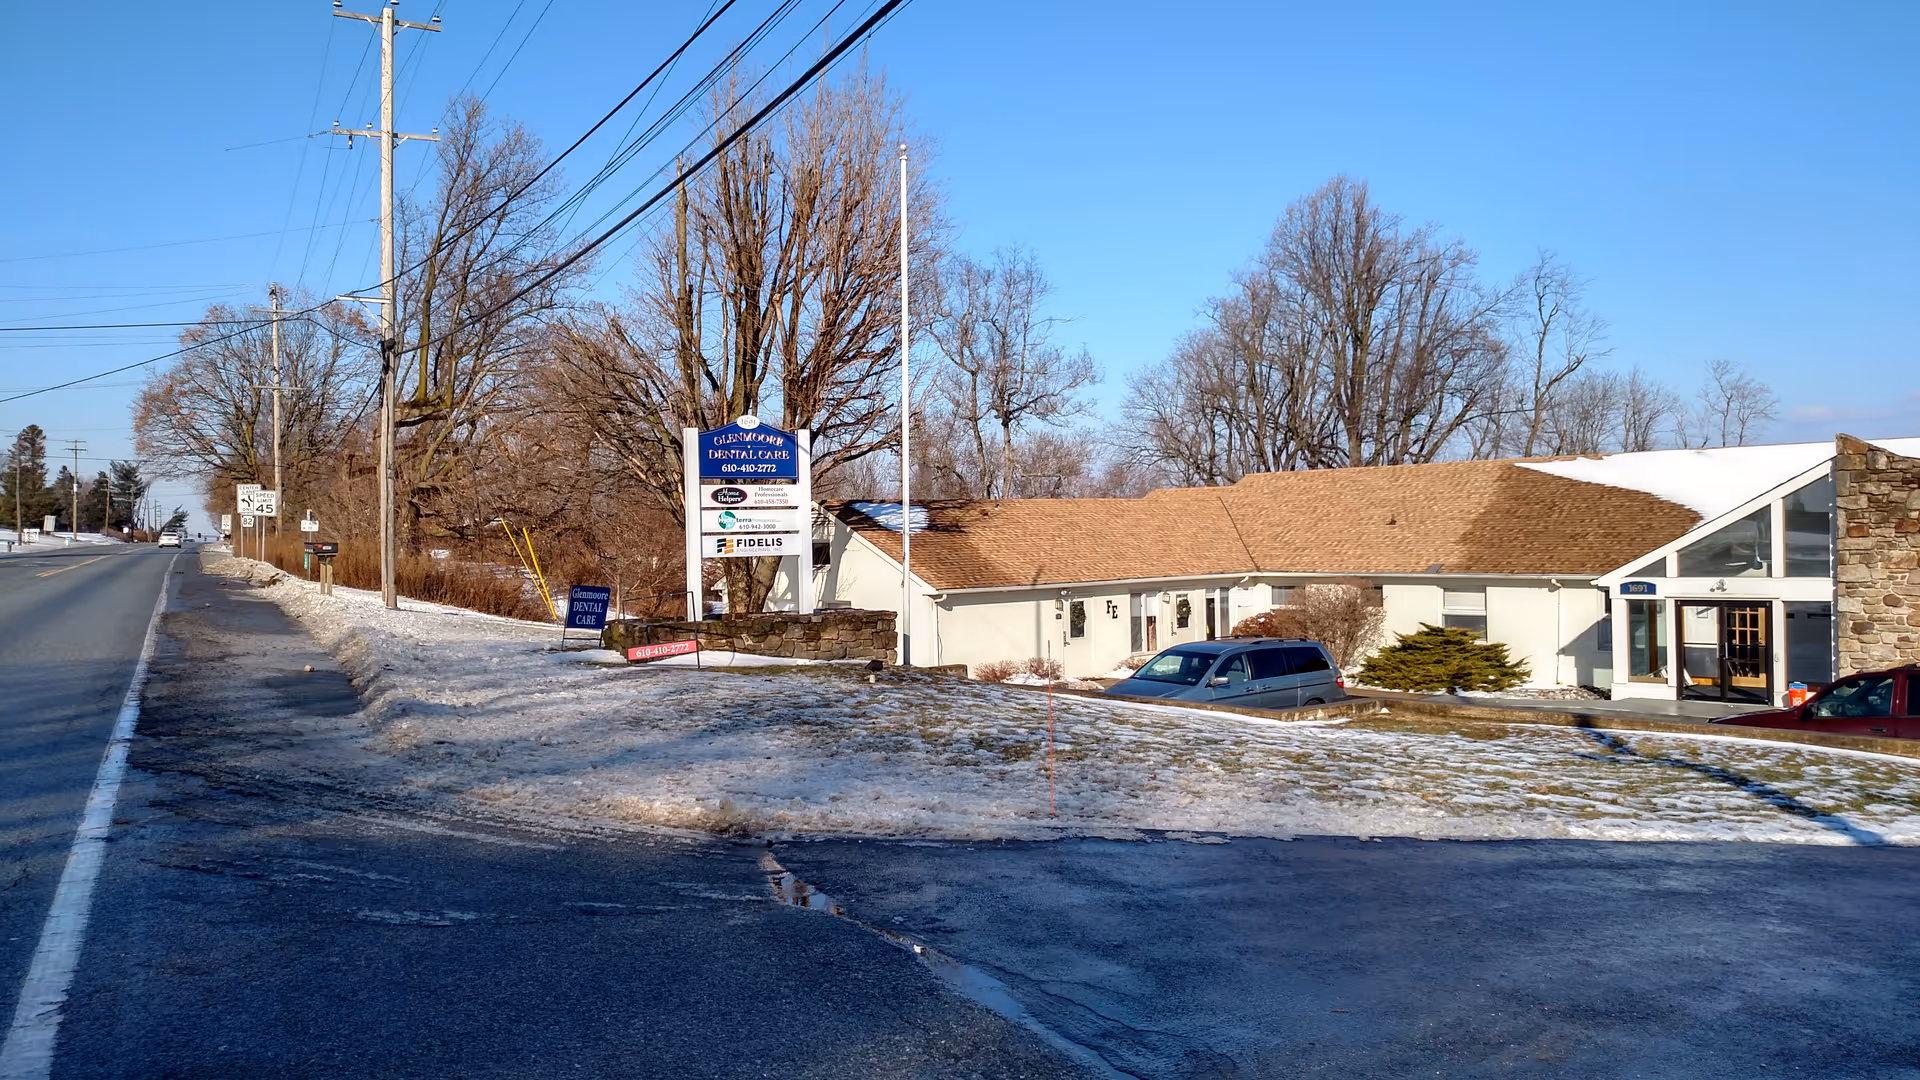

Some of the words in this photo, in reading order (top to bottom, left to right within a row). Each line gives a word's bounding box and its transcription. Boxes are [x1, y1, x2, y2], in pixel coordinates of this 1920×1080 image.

[713, 432, 784, 447] GLENMOORE
[708, 449, 756, 459] DENTAL
[758, 450, 790, 460] CARE
[721, 464, 777, 473] 610-410-2772
[255, 503, 274, 514] 45
[243, 517, 253, 525] 82
[736, 537, 783, 548] FIDELIS
[572, 587, 609, 600] Glenmoore
[1628, 584, 1648, 593] 1691
[573, 601, 603, 613] DENTAL
[576, 614, 597, 625] CARE
[636, 643, 690, 657] 610-410-2772
